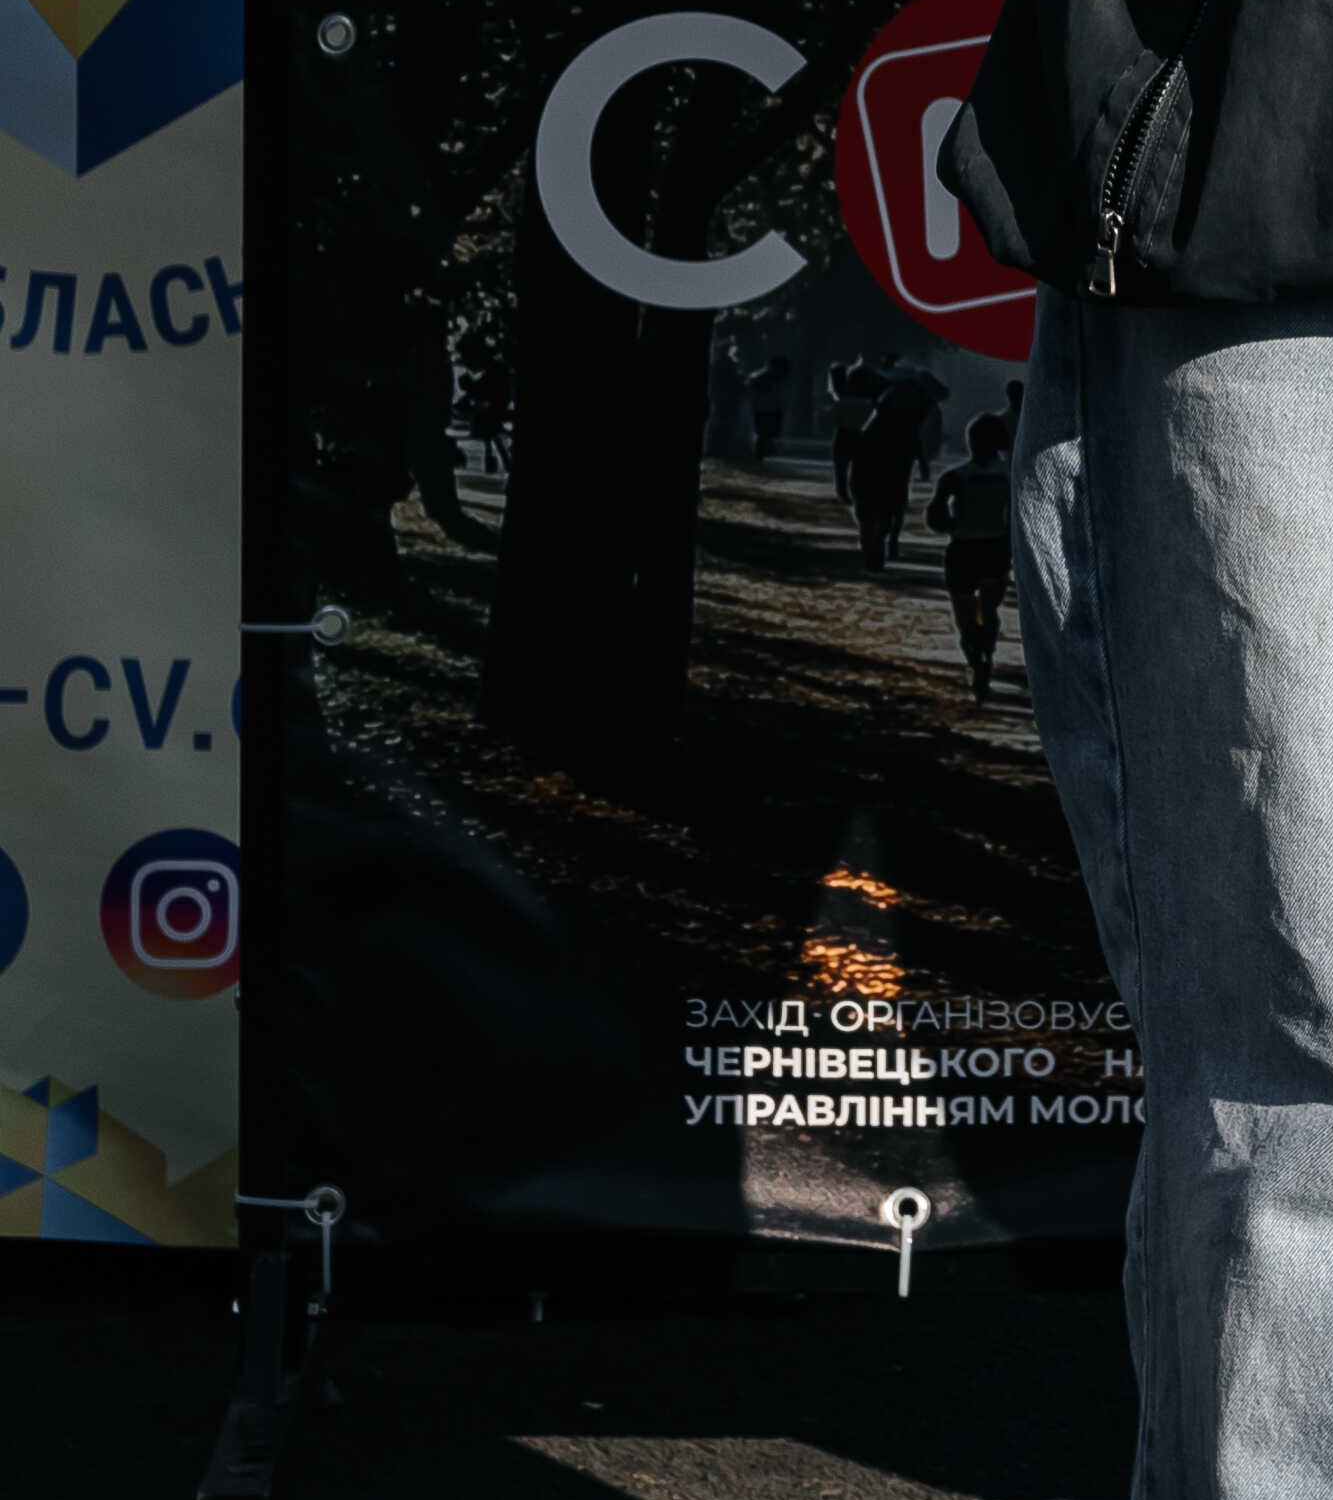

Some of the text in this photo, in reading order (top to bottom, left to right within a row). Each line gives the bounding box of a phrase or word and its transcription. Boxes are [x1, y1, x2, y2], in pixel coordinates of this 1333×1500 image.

[686, 999, 808, 1037] ЗАХІД
[684, 1047, 1057, 1086] ЧЕРНІВЕЦЬКОГО
[1105, 1048, 1144, 1078] Н
[684, 1094, 1015, 1128] УПРАВЛІННЯМ
